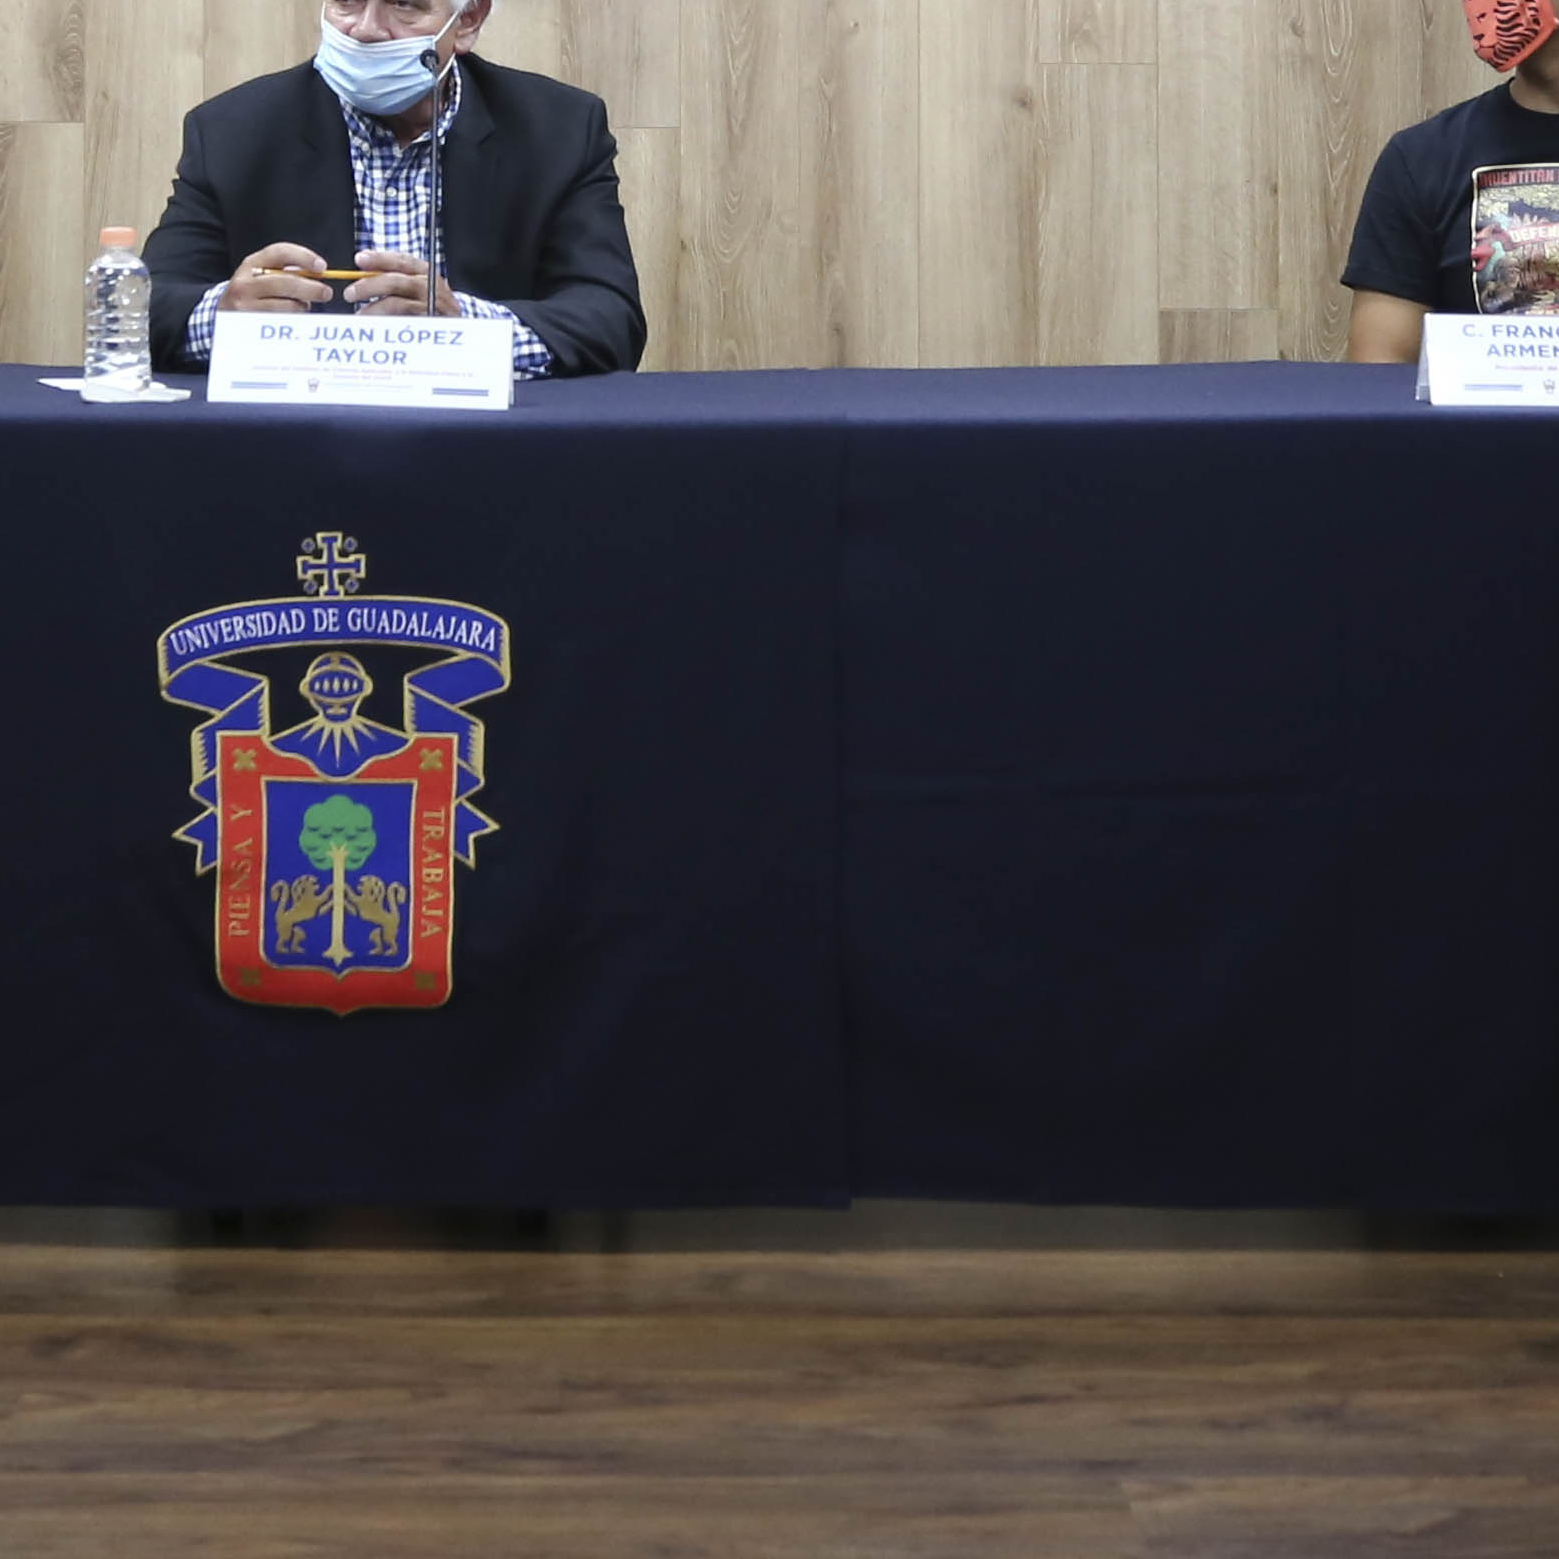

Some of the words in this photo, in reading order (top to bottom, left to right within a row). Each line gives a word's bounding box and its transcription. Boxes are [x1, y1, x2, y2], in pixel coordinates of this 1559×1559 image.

[260, 324, 299, 340] DR.
[309, 326, 374, 343] JUAN
[384, 325, 463, 345] LÓPEZ
[1462, 323, 1483, 337] C.
[313, 346, 407, 365] TAYLOR
[169, 607, 305, 655] UNIVERSIDAD
[313, 607, 339, 632] DE
[347, 606, 496, 651] GUADALAJARA
[230, 803, 254, 822] Y
[421, 806, 446, 938] TRABAJA
[228, 836, 253, 937] PIENSA
